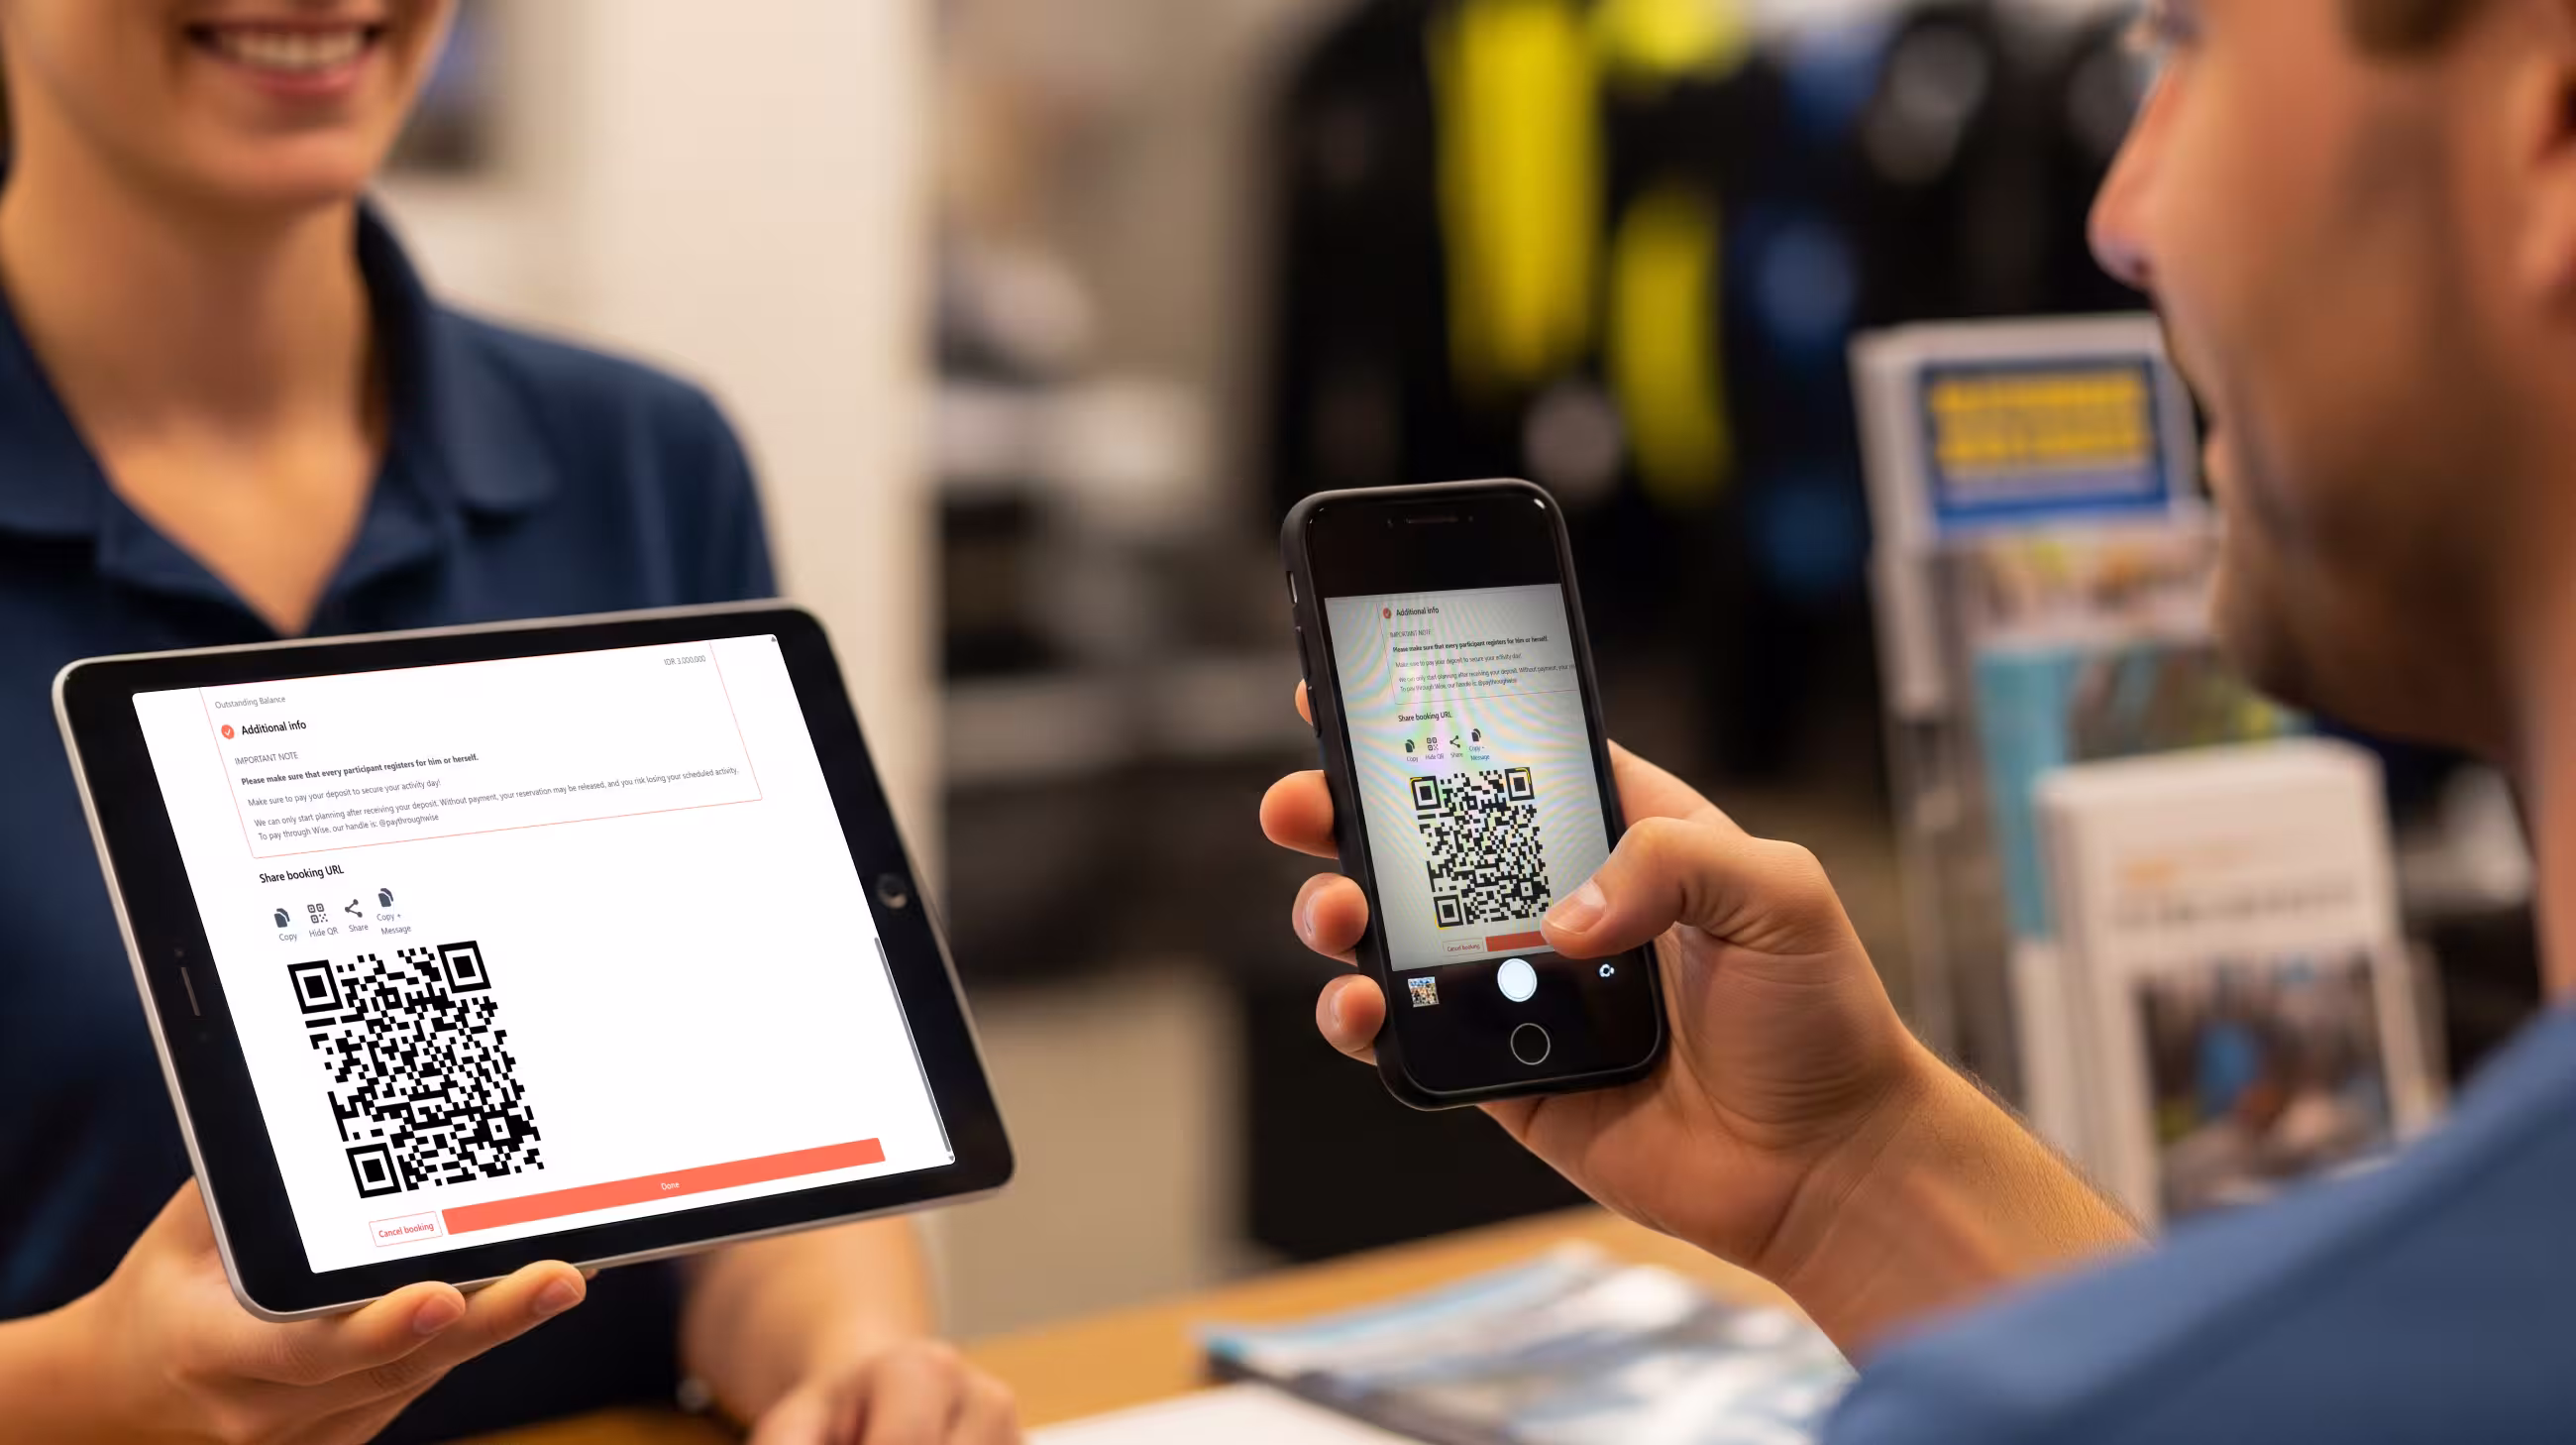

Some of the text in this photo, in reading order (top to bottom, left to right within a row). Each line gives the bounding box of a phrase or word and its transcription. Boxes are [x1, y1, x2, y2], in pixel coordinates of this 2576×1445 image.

[1396, 608, 1426, 616] Additional
[663, 657, 677, 666] IDR
[214, 696, 286, 710] Outstanding Balance
[241, 719, 307, 735] Additional info
[234, 750, 299, 765] IMPORTANT NOTE
[241, 777, 266, 786] Please
[266, 773, 287, 783] make
[304, 770, 321, 779] that
[321, 769, 342, 778] every
[343, 763, 383, 777] participant
[383, 761, 415, 772] registers
[414, 758, 427, 767] for
[427, 757, 443, 766] him
[451, 752, 480, 763] herself.
[247, 797, 268, 807] Make
[293, 794, 307, 804] pay
[307, 792, 324, 803] your
[325, 788, 352, 800] deposit
[361, 786, 383, 795] secure
[383, 784, 400, 794] your
[401, 780, 425, 790] activity
[426, 778, 442, 789] day!
[253, 819, 267, 828] We
[280, 815, 297, 826] only
[297, 813, 314, 823] start
[314, 810, 346, 823] planning
[346, 808, 363, 817] after
[363, 804, 395, 815] receiving
[394, 804, 411, 814] your
[411, 799, 440, 811] deposit.
[438, 796, 468, 807] Without
[467, 793, 499, 805] payment,
[498, 792, 515, 802] your
[515, 787, 553, 798] reservation
[552, 786, 567, 795] may
[577, 780, 607, 791] released,
[606, 778, 620, 788] and
[620, 779, 634, 789] you
[633, 776, 647, 785] risk
[645, 774, 667, 784] losing
[666, 773, 682, 783] your
[682, 768, 714, 780] scheduled
[714, 766, 739, 776] activity.
[257, 832, 268, 840] To
[268, 832, 281, 841] pay
[282, 828, 312, 838] through
[344, 821, 370, 831] handle
[369, 820, 378, 829] is:
[378, 813, 440, 828] @paythroughwise
[259, 863, 345, 884] Share booking URL
[376, 913, 394, 922] Copy
[308, 926, 339, 938] Hide QR
[348, 924, 369, 933] Share
[380, 926, 412, 936] Message
[278, 933, 297, 943] Copy
[377, 1222, 435, 1238] Cancel booking
